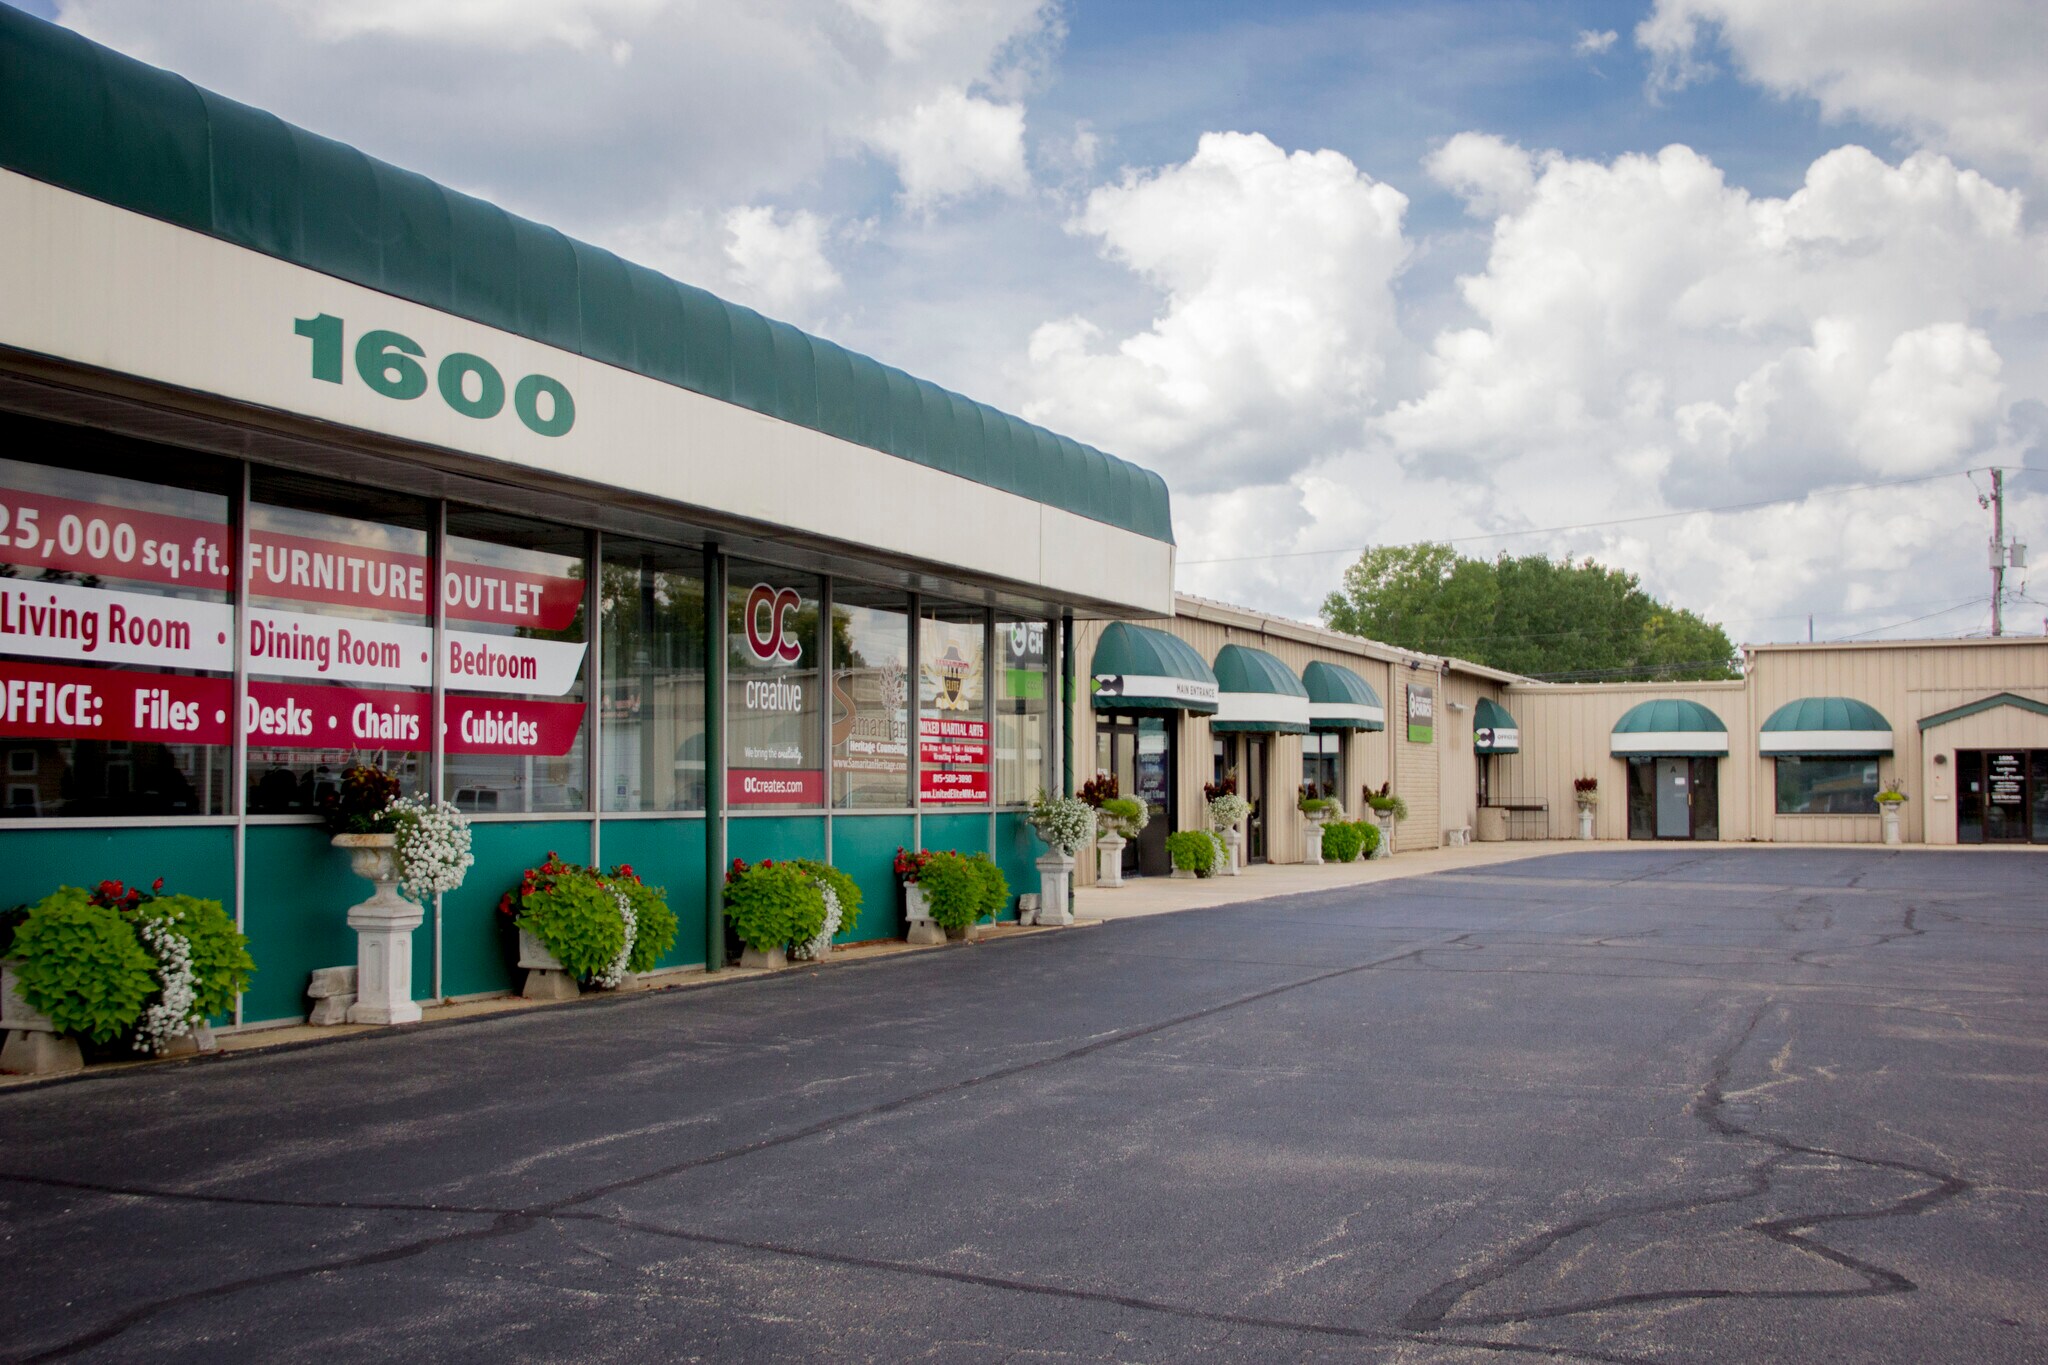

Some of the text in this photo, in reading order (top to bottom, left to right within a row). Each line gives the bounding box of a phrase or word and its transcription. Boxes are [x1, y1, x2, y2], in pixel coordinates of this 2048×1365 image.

[294, 312, 576, 437] 1600
[142, 537, 230, 579] sq.ft.
[249, 543, 424, 601] FURNITURE
[445, 573, 543, 616] OUTLET
[1, 591, 536, 680] Living Room Dining Room Bedroom
[745, 583, 802, 663] OC
[746, 675, 801, 712] creative
[946, 680, 961, 692] ELITE
[1176, 682, 1215, 698] MAIN ENTRANCE
[135, 688, 200, 731] Files
[246, 696, 313, 736] Desks
[352, 703, 419, 740] Chairs
[461, 709, 538, 745] Cubicles
[920, 720, 984, 737] MIXED MARTIAL ARTS
[744, 746, 754, 758] We
[754, 747, 768, 761] bring
[768, 748, 777, 758] the
[850, 740, 876, 755] Heritage
[744, 776, 803, 793] OCcreates.com
